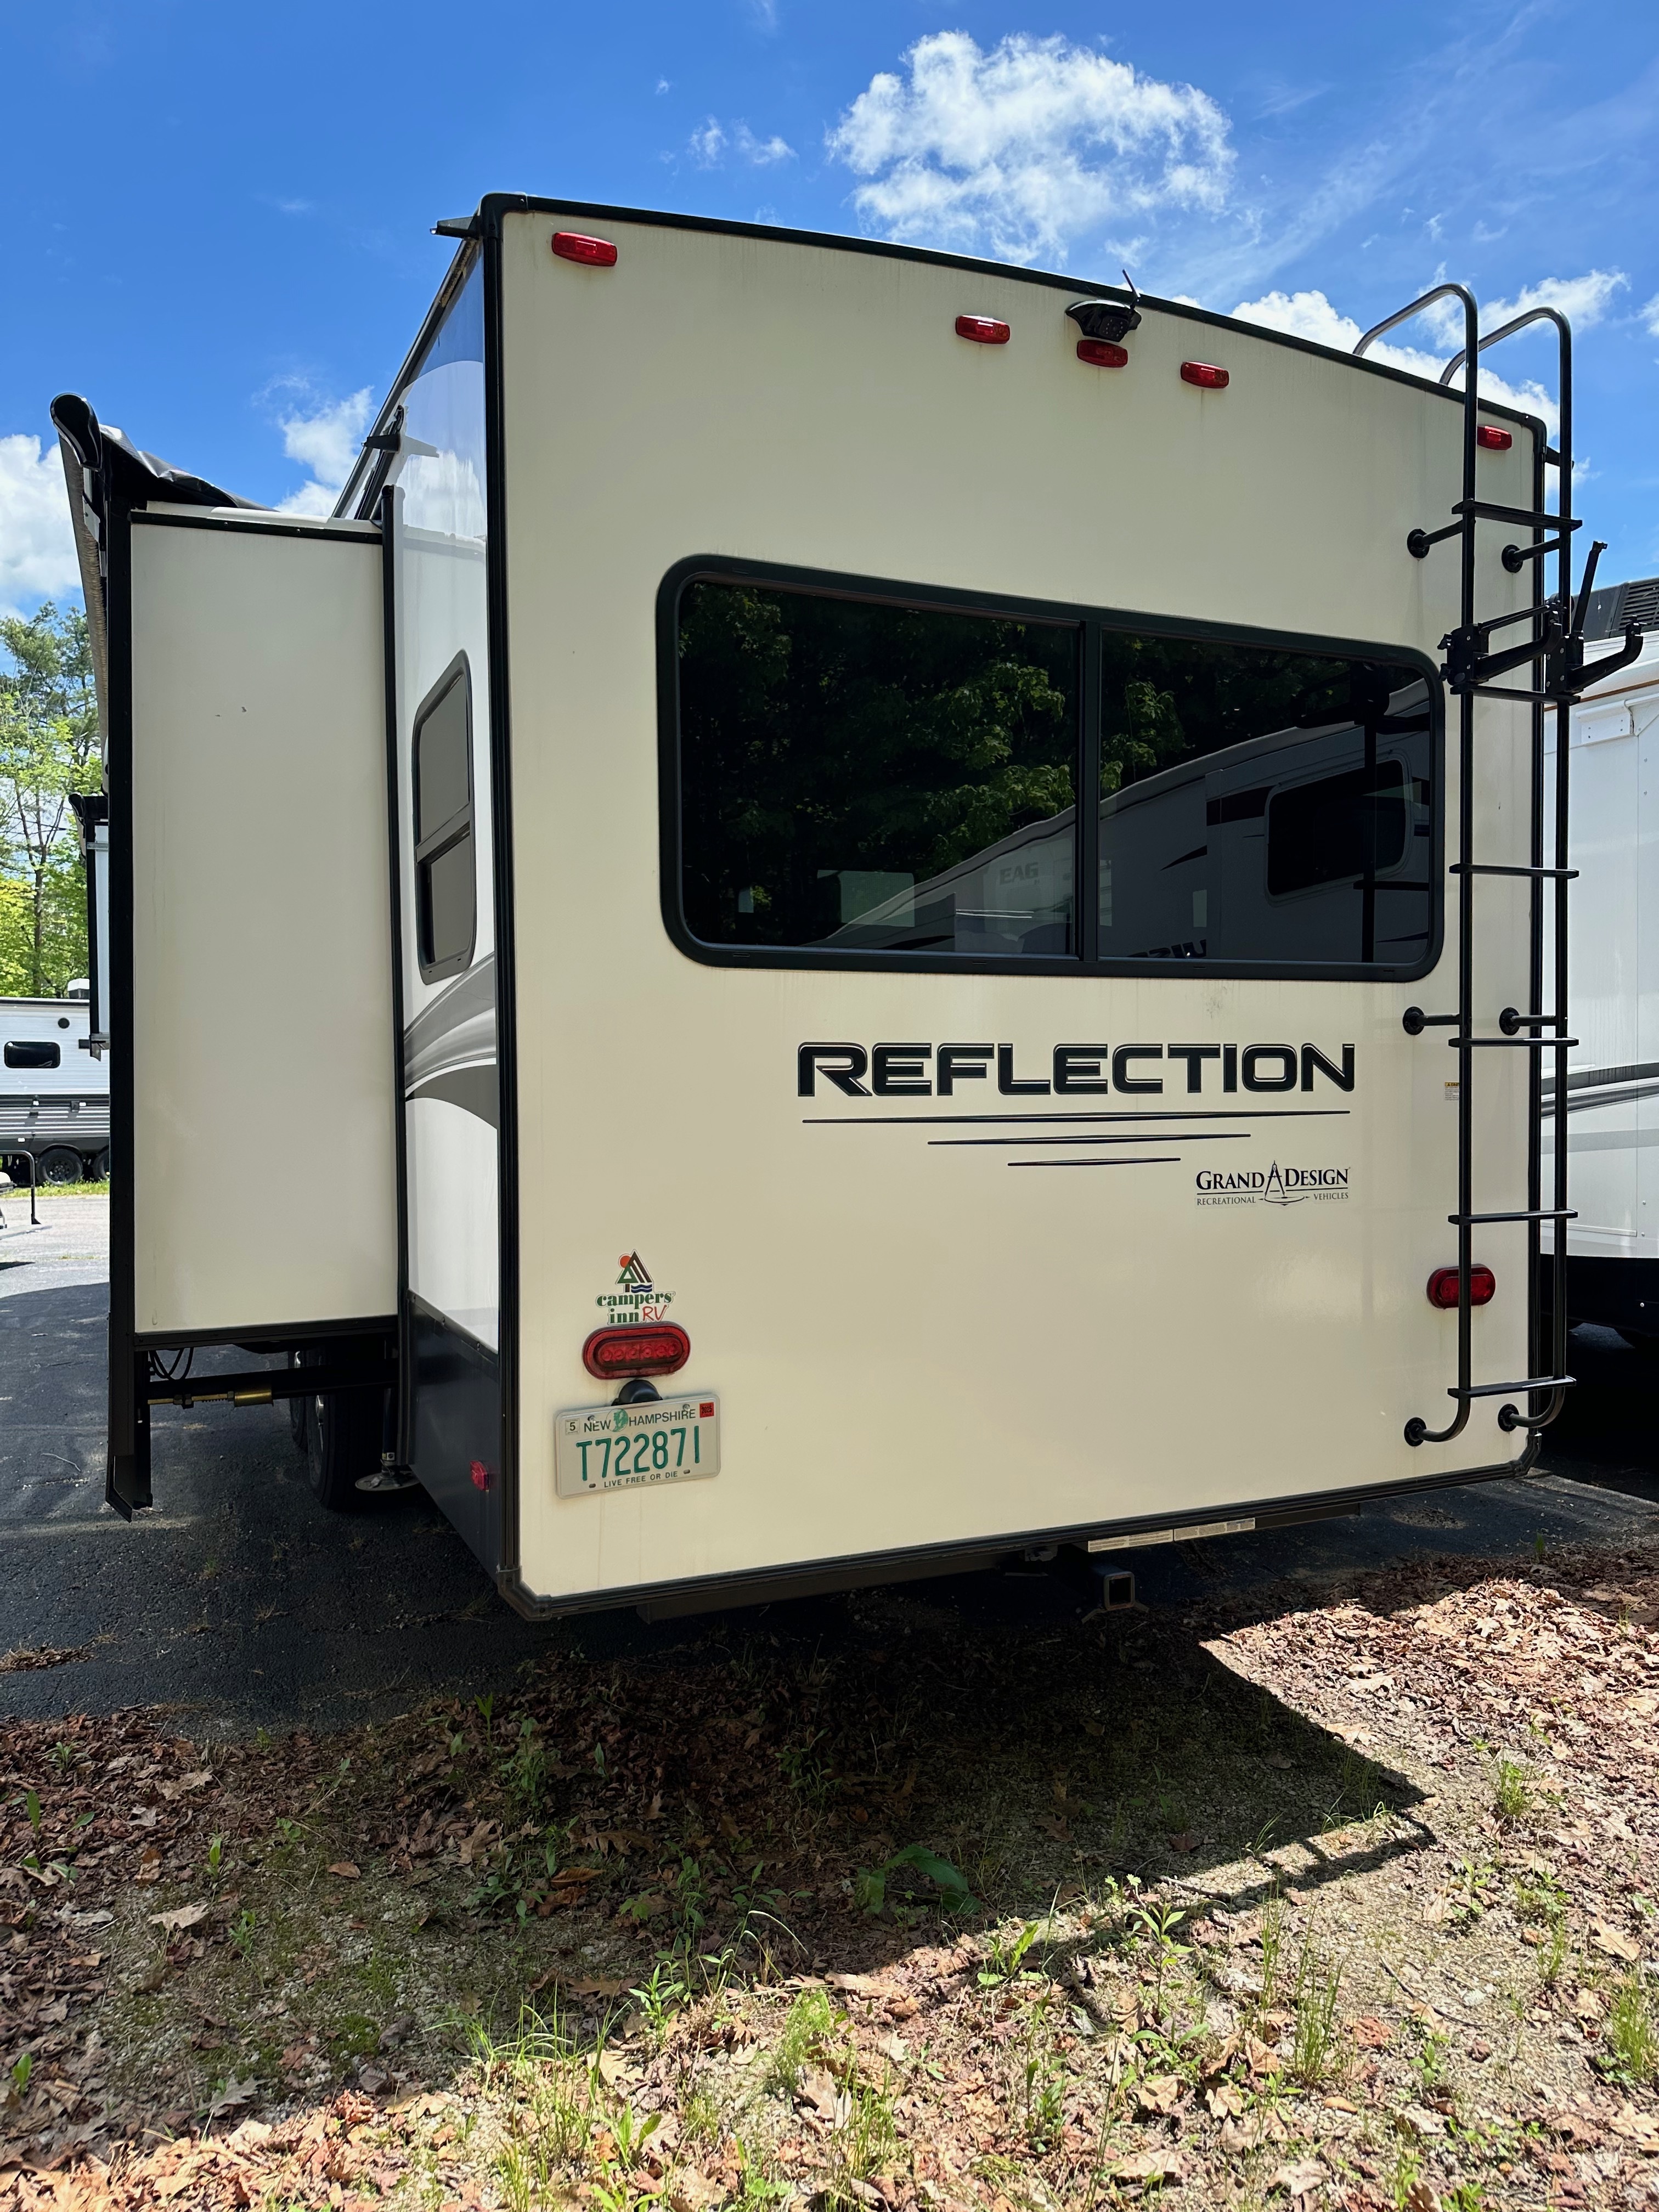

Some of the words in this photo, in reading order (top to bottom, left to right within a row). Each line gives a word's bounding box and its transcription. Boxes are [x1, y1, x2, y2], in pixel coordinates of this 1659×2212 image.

[797, 1042, 1355, 1097] REFLECTION
[1196, 1171, 1265, 1190] GRAND
[1284, 1168, 1349, 1187] DESIGN
[1197, 1196, 1256, 1206] RECREATIONAL
[1313, 1192, 1349, 1200] VEHICLES
[596, 1293, 672, 1310] campers
[610, 1308, 640, 1323] inn
[642, 1304, 668, 1322] RV
[569, 1421, 575, 1431] 5
[584, 1420, 611, 1432] NEW
[629, 1409, 696, 1427] HAMPSHIRE
[575, 1425, 700, 1481] T722871
[626, 1475, 646, 1485] FREE
